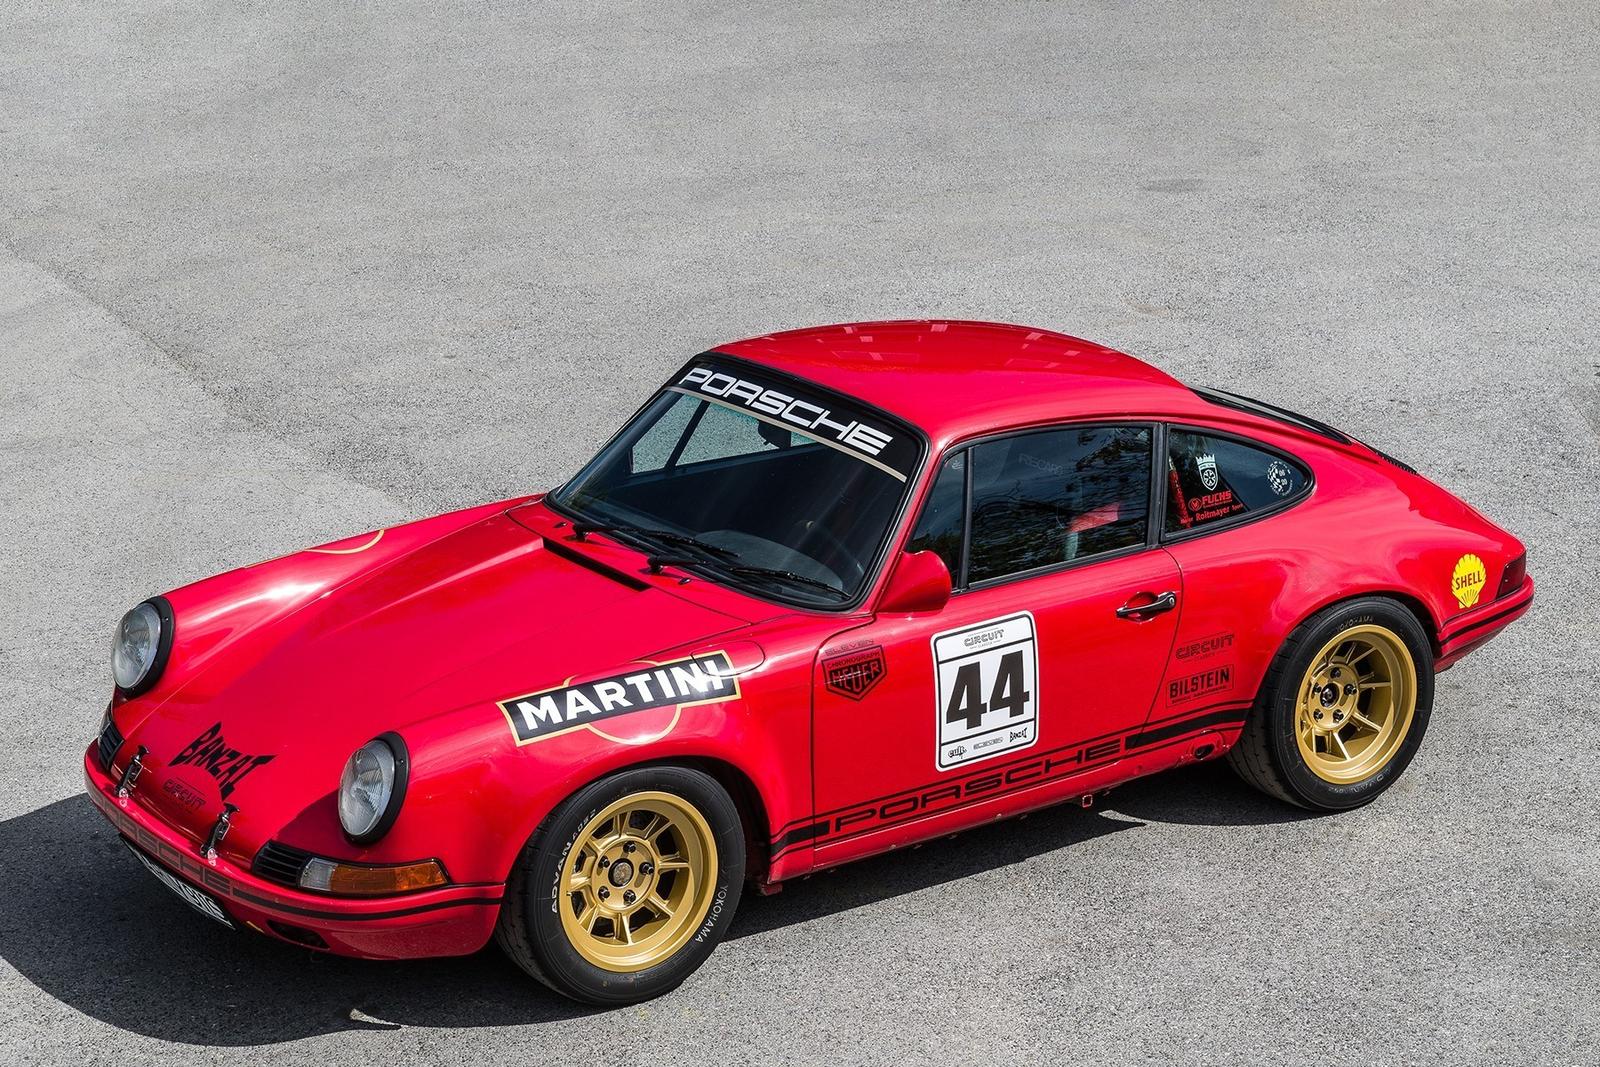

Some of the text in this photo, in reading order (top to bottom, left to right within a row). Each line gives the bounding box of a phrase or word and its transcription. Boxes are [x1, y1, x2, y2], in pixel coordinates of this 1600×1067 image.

[678, 367, 894, 456] PORSCHE
[1202, 490, 1232, 505] FUCHS
[1455, 571, 1483, 590] SHELL
[963, 628, 1005, 648] CIRCUIT
[1176, 634, 1235, 660] CIRCUIT
[831, 660, 881, 693] HEUER
[946, 649, 1029, 730] 44
[1169, 667, 1230, 699] BILSTEIN
[516, 659, 724, 731] MARTINI
[162, 778, 207, 808] CIRCUIT
[835, 738, 1122, 833] PORSCHE
[551, 841, 573, 914] ADVAN
[695, 884, 729, 944] YOKOHAMA
